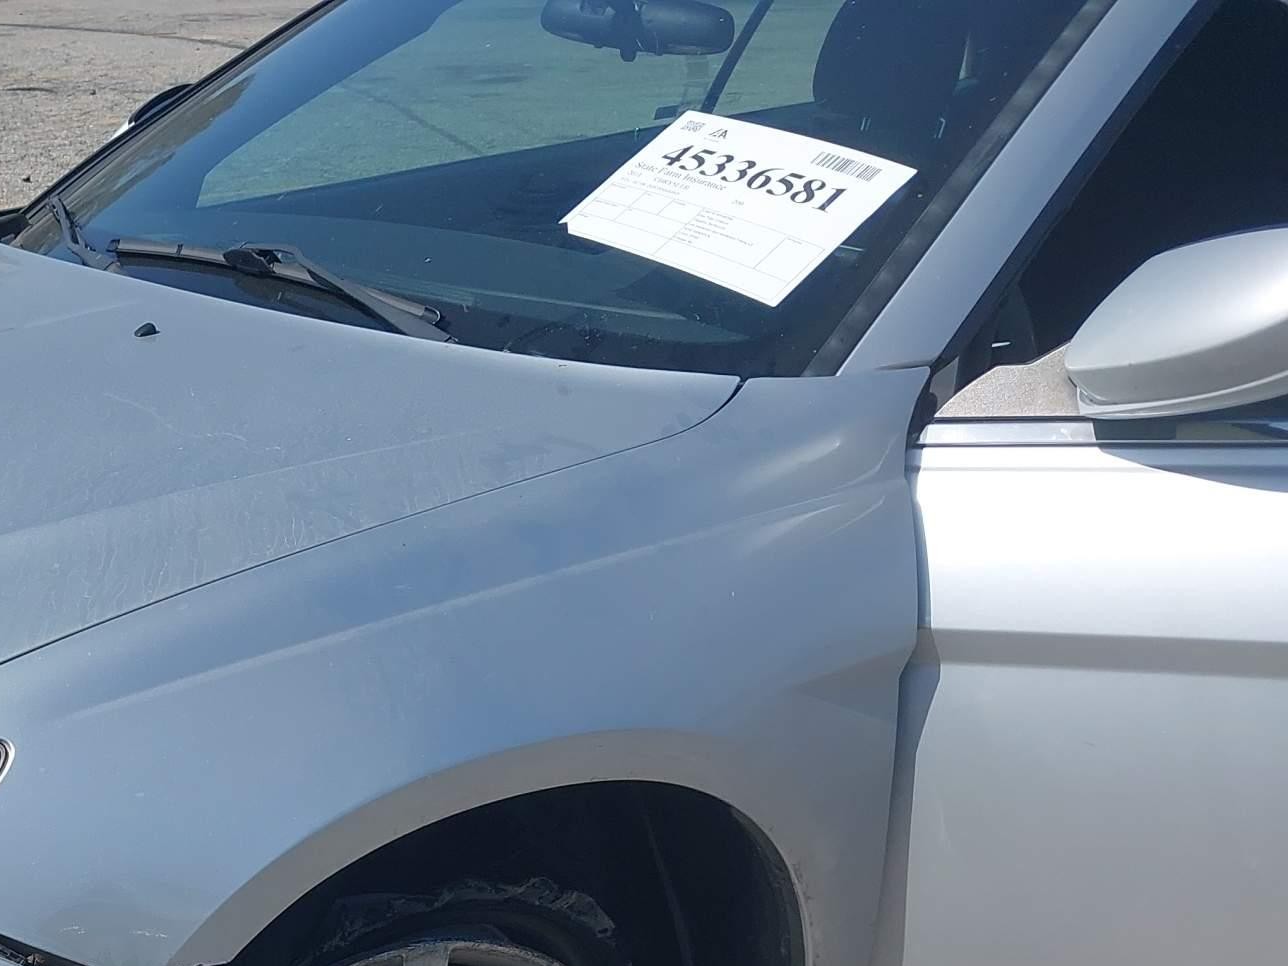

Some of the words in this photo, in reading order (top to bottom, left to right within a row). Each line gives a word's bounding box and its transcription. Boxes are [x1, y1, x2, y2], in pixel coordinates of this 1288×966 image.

[634, 161, 658, 173] State
[657, 167, 682, 179] Farm
[682, 173, 727, 191] Insurance
[662, 145, 848, 212] 45336581
